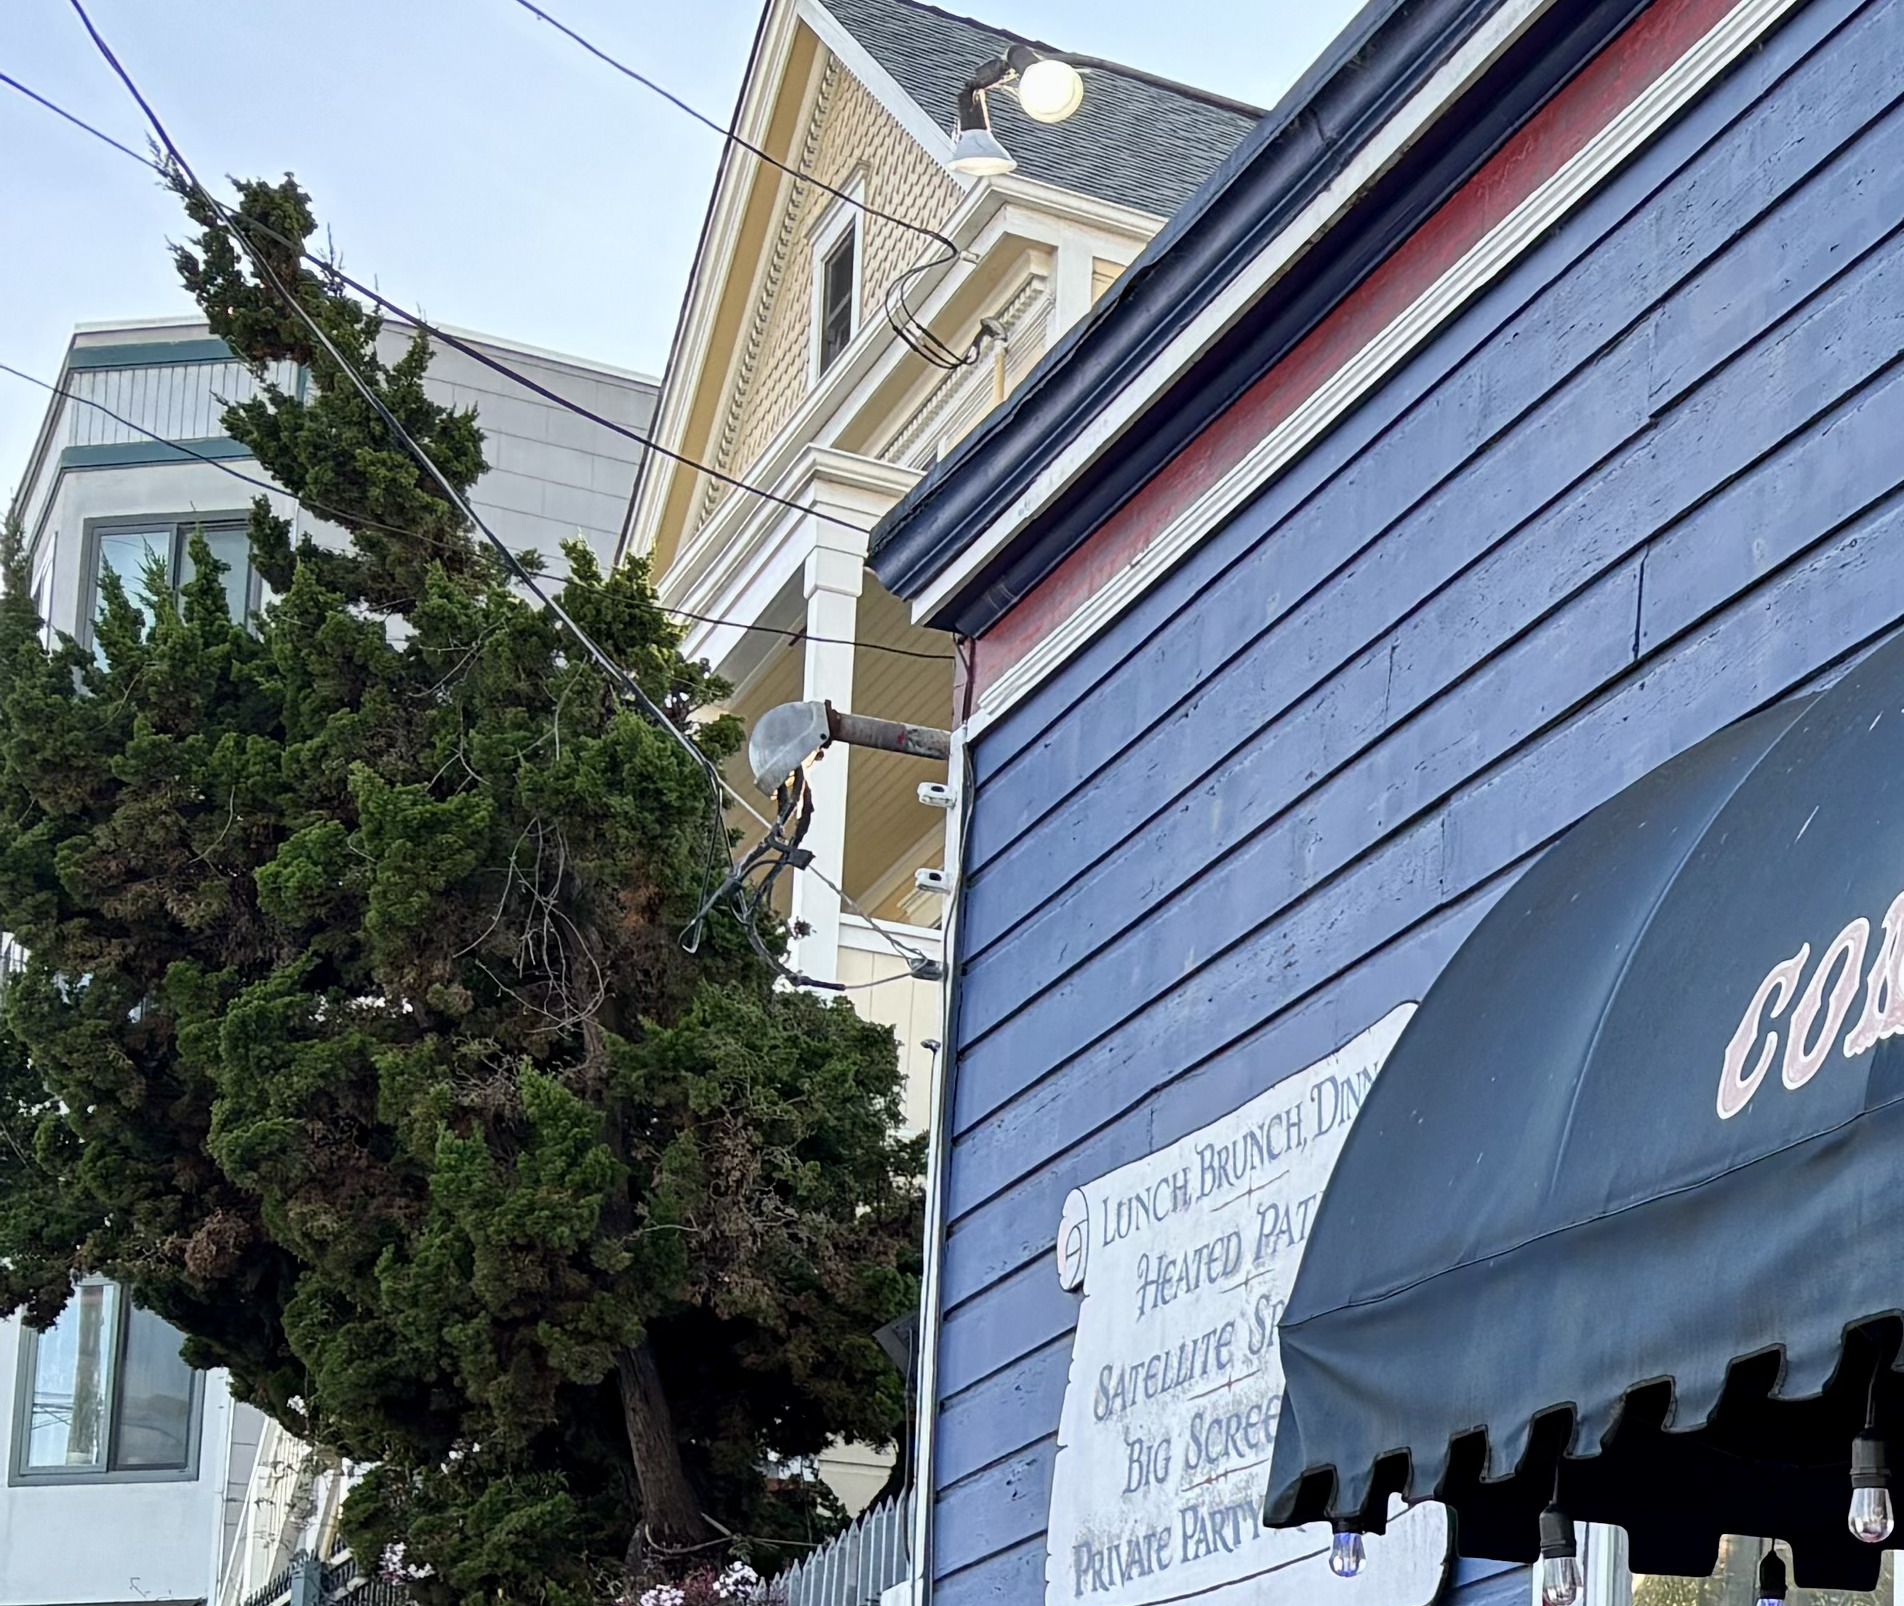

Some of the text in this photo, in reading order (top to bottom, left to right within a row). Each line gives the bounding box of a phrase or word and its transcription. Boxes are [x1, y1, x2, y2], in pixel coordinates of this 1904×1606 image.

[1102, 1166, 1192, 1249] LUNCH,
[1195, 1102, 1307, 1200] BRUNCH,
[1136, 1190, 1325, 1323] HEATED PAT
[1094, 1320, 1236, 1421] SATELLITE
[1122, 1425, 1172, 1495] BIG
[1072, 1501, 1264, 1598] PRIVATE PARTY
